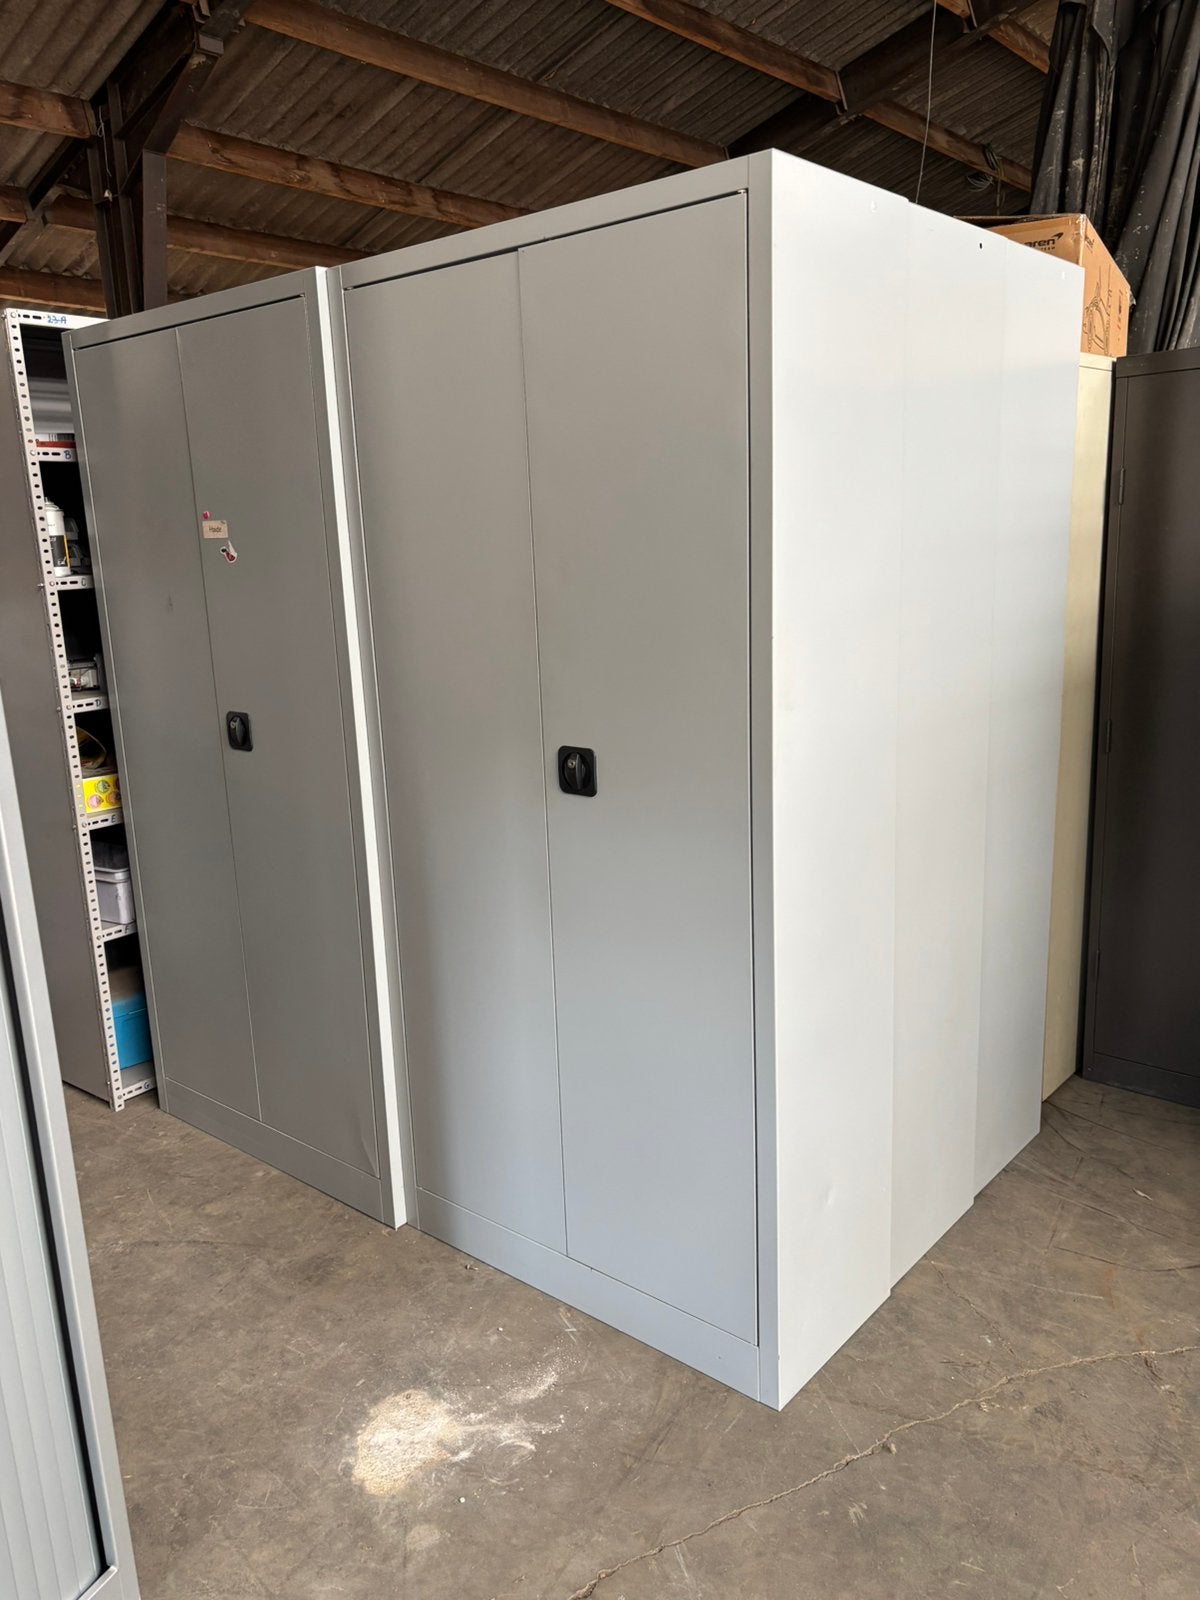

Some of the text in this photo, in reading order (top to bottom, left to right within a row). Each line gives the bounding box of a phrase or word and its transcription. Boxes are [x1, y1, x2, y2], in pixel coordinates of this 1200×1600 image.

[63, 450, 72, 460] B
[95, 698, 102, 708] D
[111, 814, 117, 824] E
